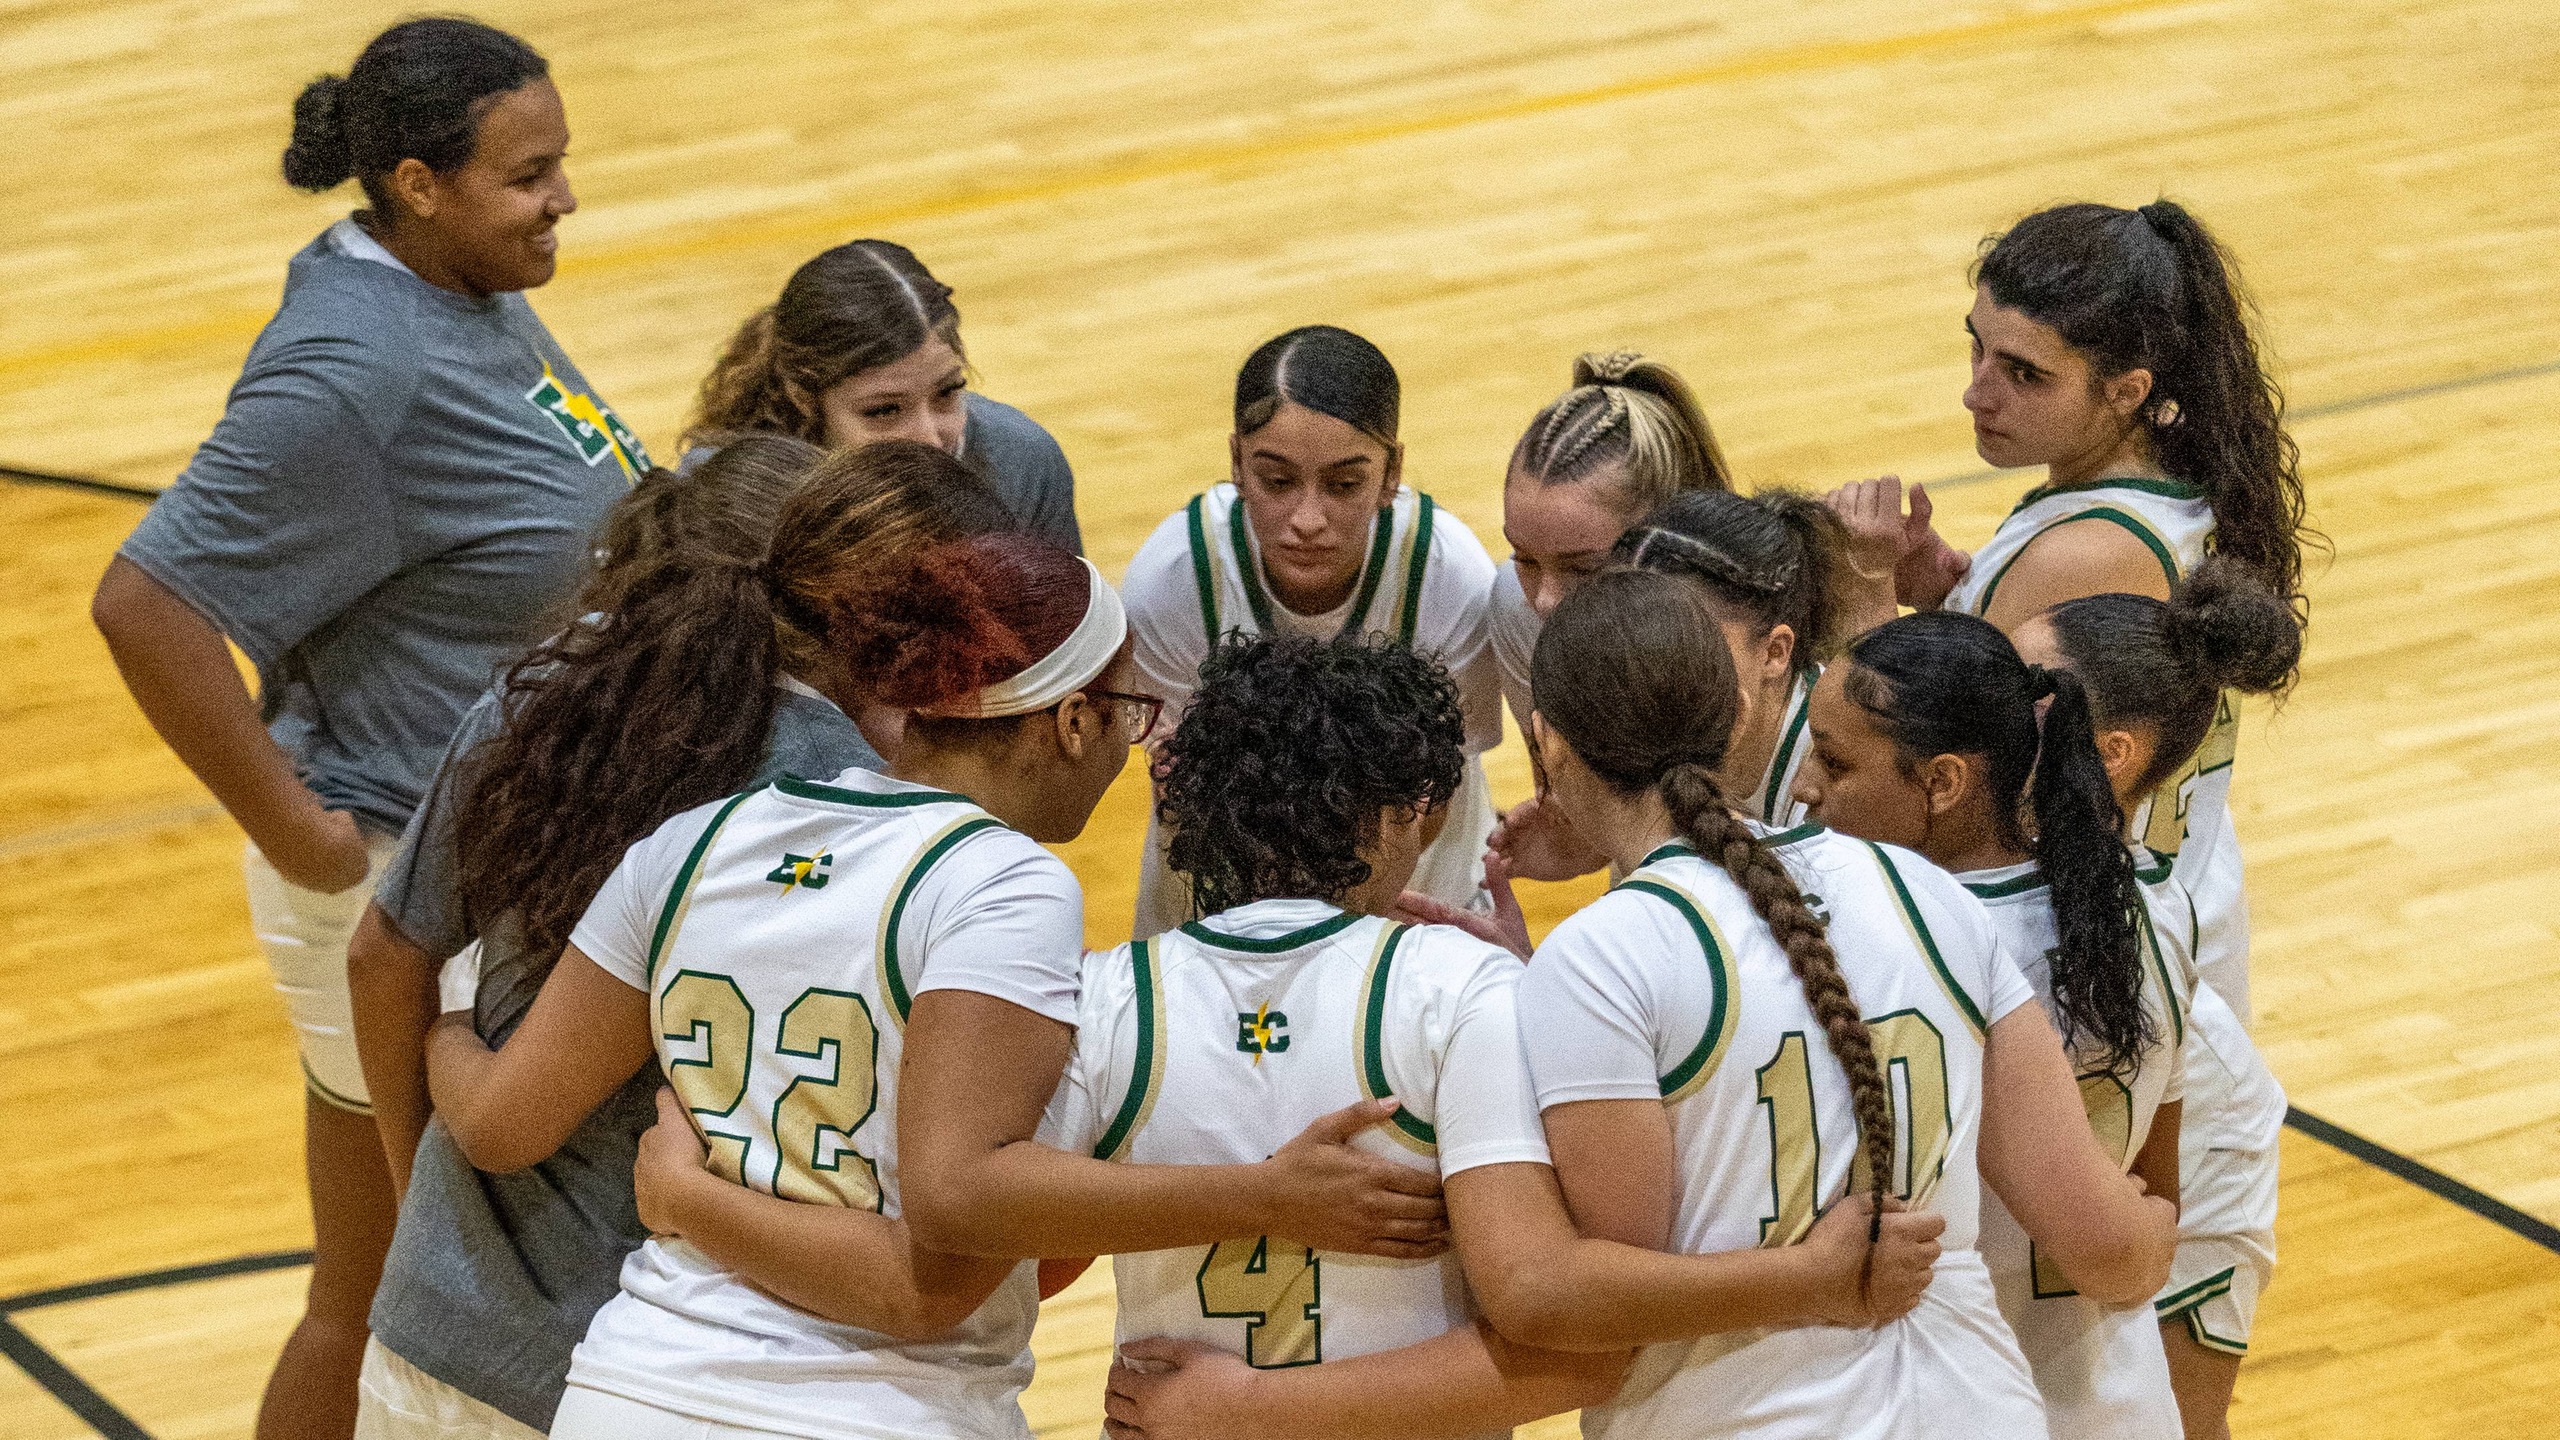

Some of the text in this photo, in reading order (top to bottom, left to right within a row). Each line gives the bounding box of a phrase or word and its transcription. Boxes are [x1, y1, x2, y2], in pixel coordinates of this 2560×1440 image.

[661, 969, 884, 1214] 22
[1236, 1011, 1290, 1053] EC
[1755, 1008, 1952, 1247] 10
[1196, 1235, 1322, 1370] 4
